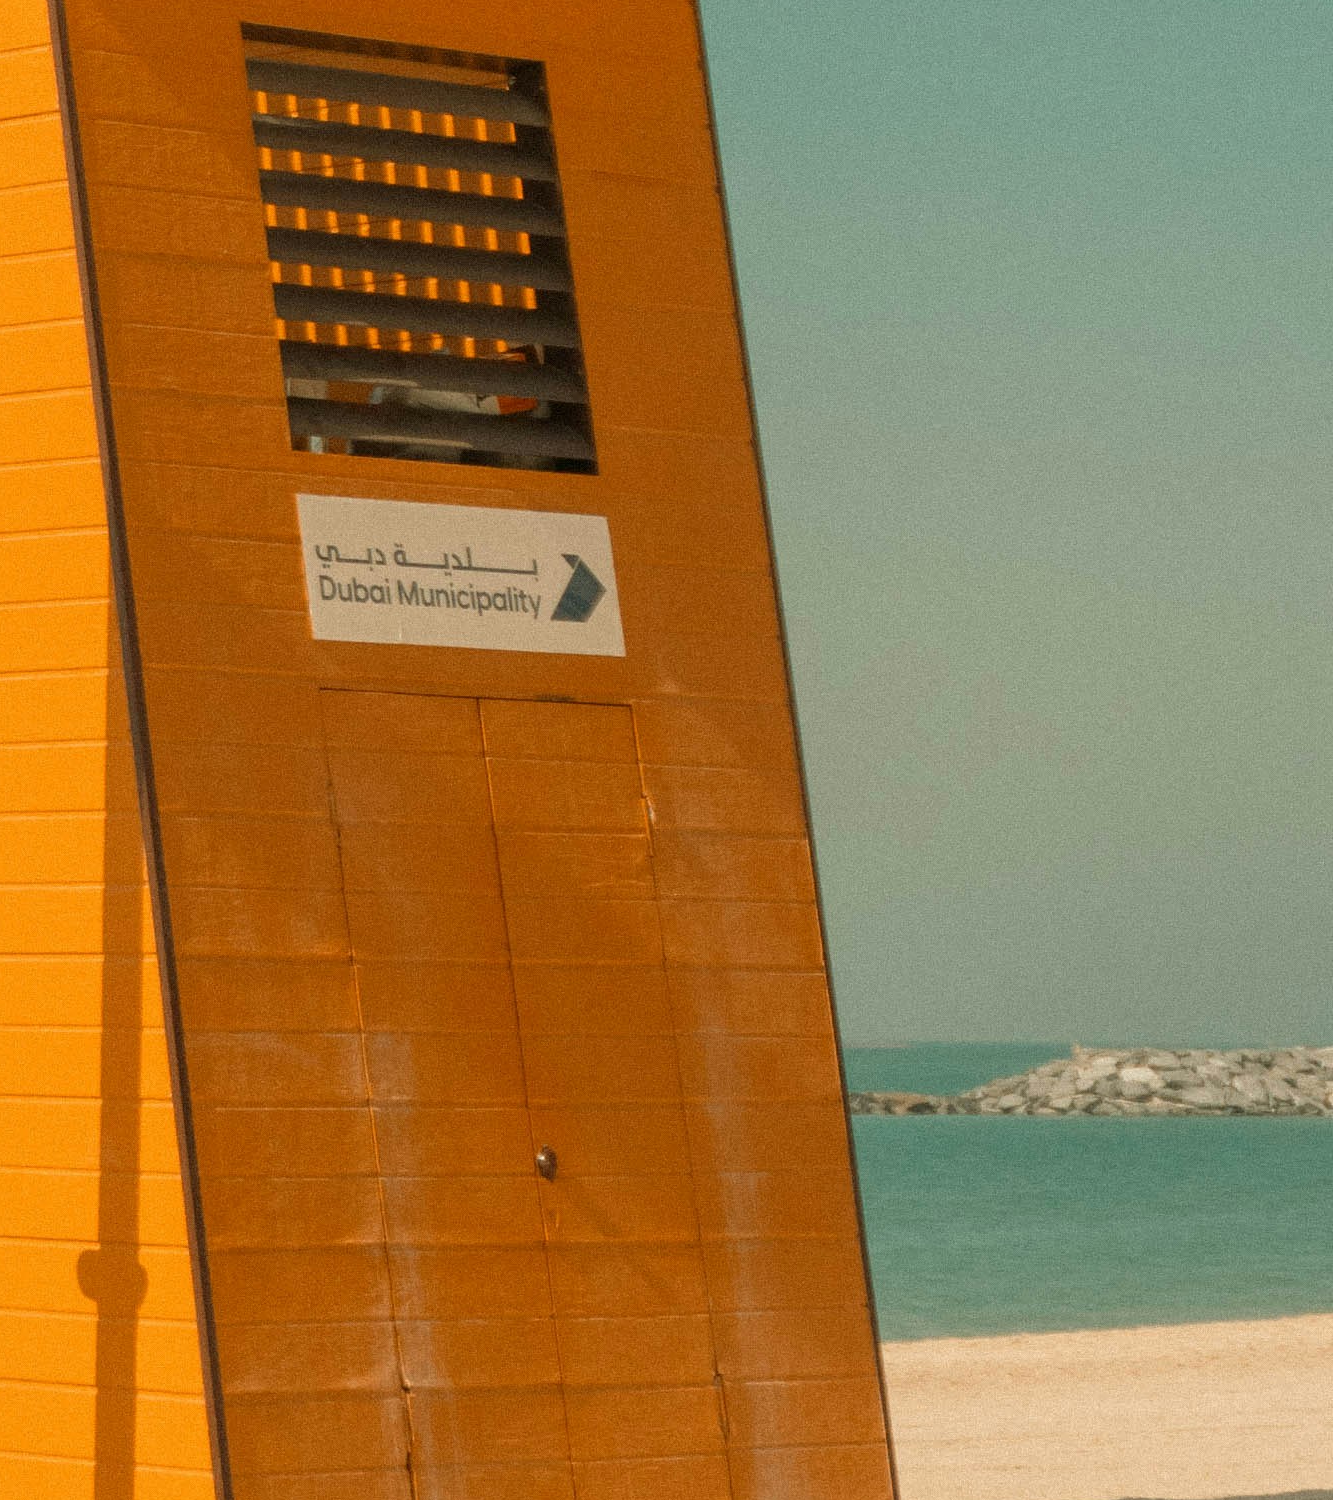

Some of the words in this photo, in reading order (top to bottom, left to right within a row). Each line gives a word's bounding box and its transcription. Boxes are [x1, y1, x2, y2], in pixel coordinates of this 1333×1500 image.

[315, 544, 387, 572] دبي
[393, 543, 539, 582] بلدية
[318, 574, 391, 605] Dubai
[397, 579, 541, 620] Municipality
